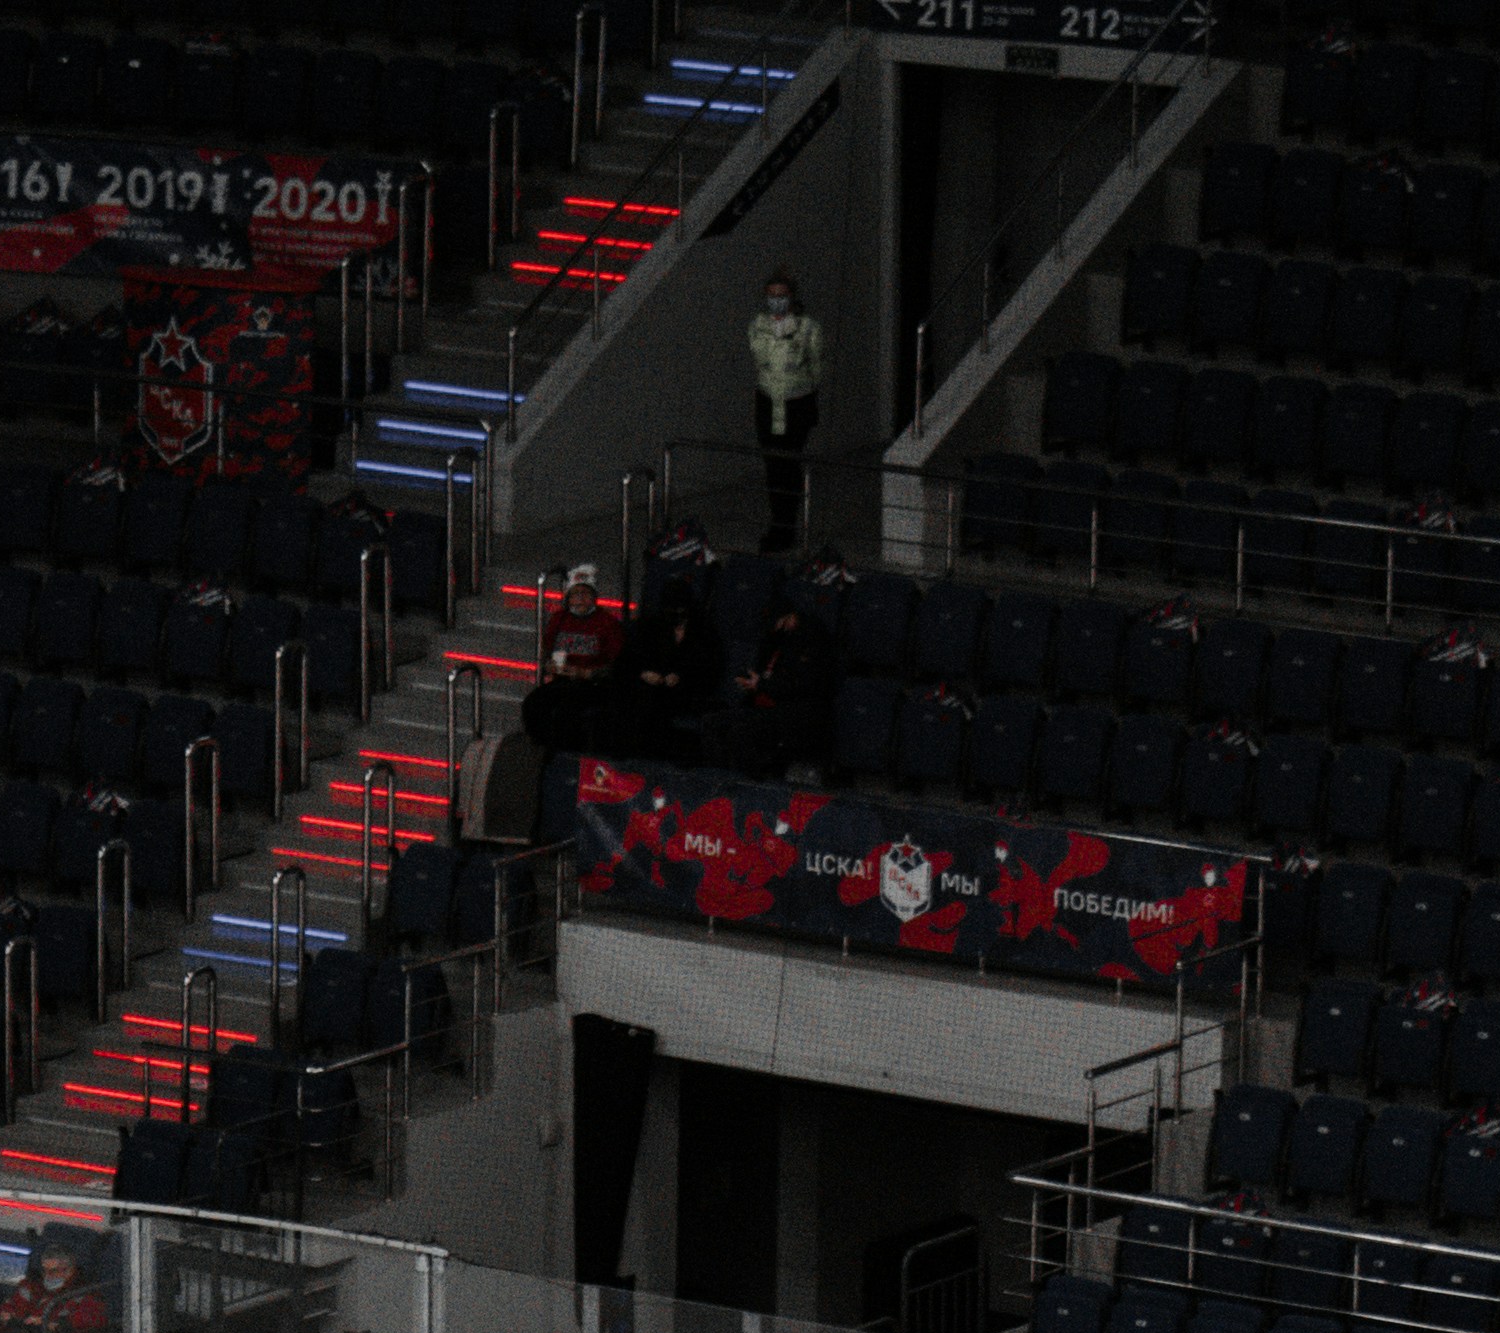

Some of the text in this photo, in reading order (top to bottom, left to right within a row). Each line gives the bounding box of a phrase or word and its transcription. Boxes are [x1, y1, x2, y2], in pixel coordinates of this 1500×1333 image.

[1059, 6, 1121, 40] 212
[99, 165, 203, 211] 2019
[252, 175, 367, 224] 2020
[683, 832, 1176, 926] МЫ ЦСКА! МЫ ПОБЕДИМ!
